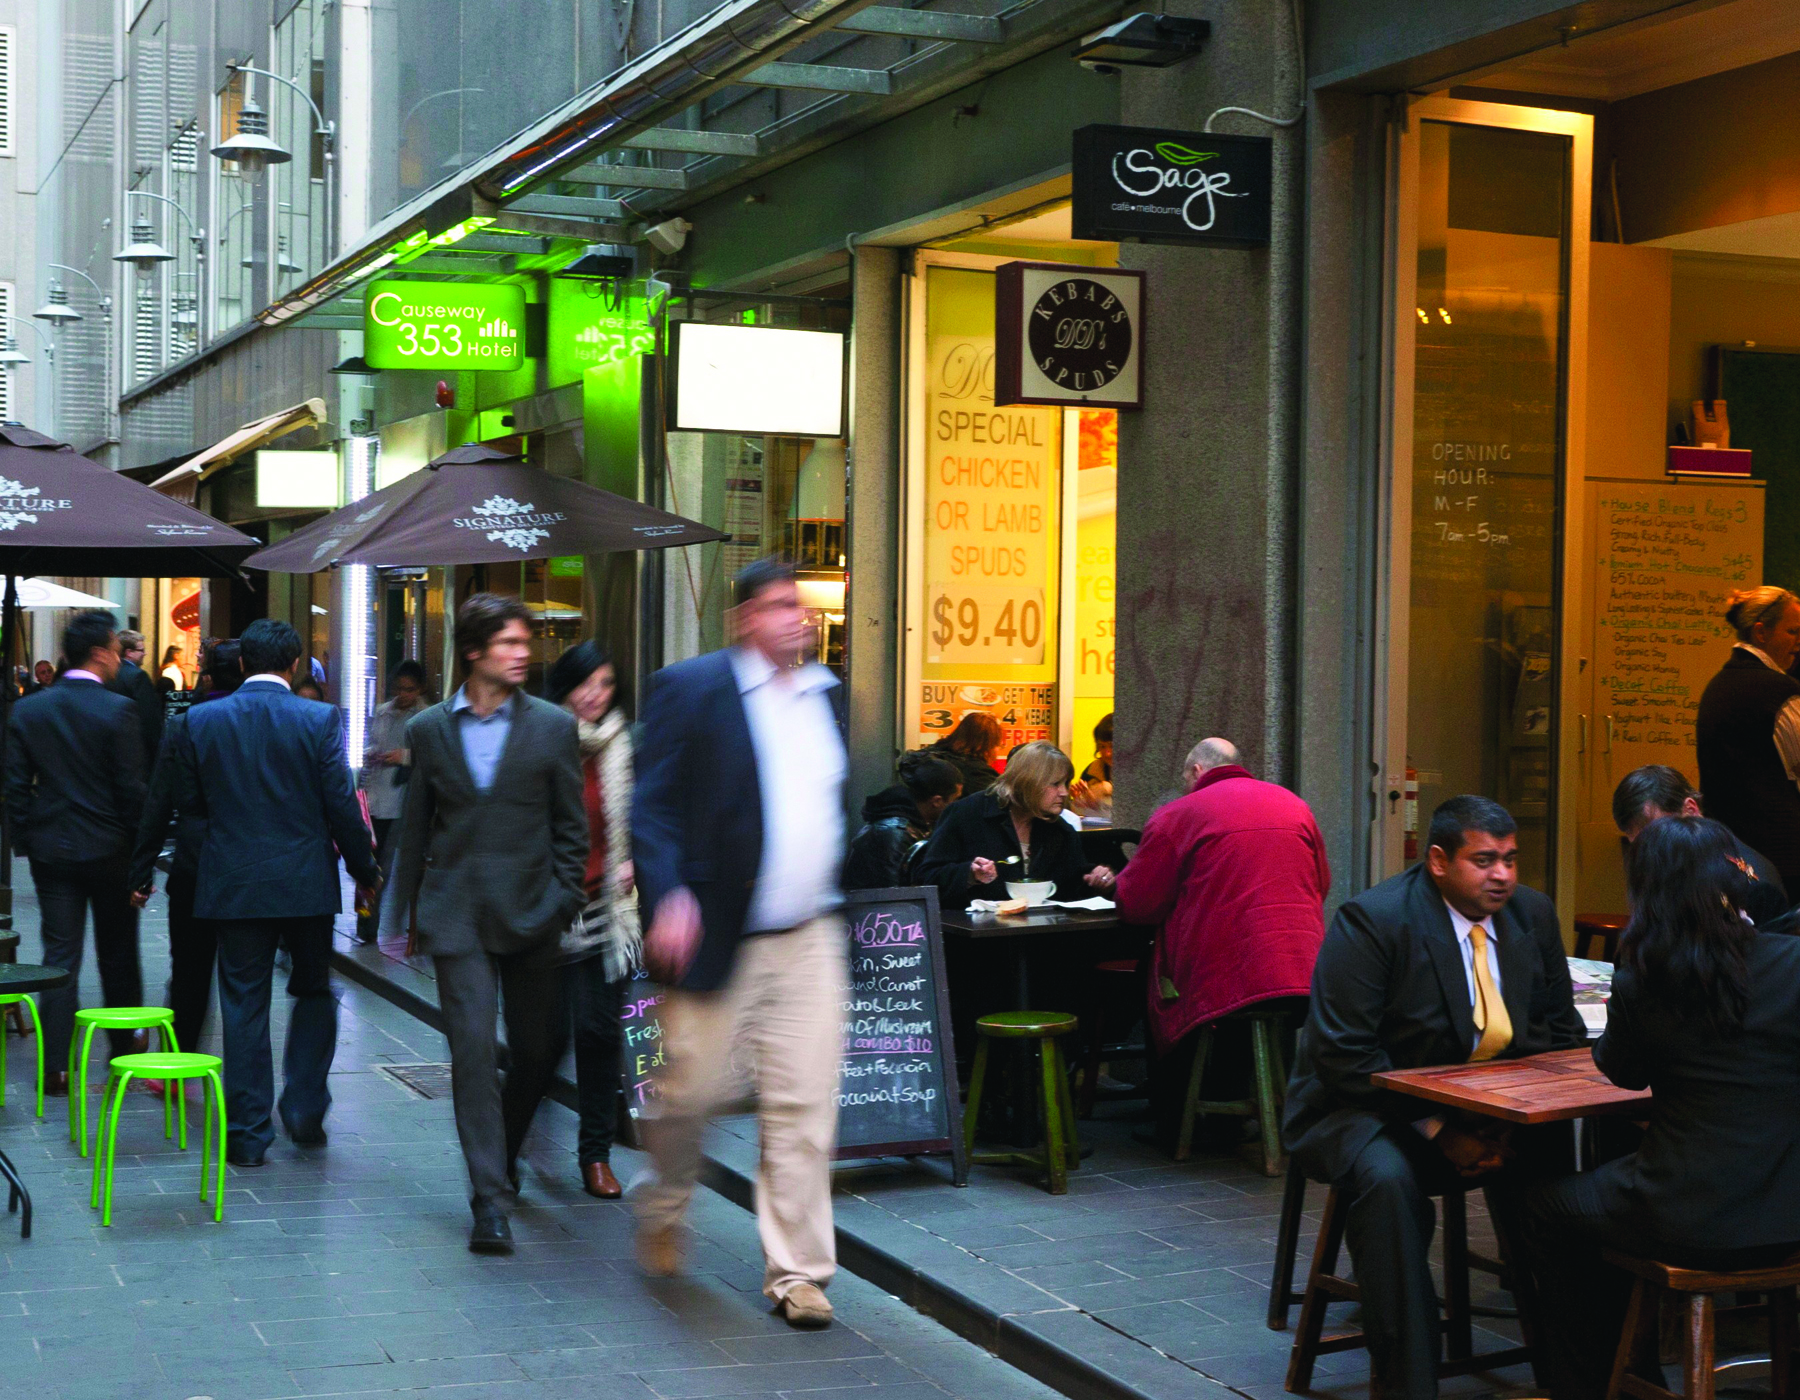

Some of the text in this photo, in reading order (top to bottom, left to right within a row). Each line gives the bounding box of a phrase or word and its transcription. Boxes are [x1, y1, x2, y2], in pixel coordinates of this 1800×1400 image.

[1112, 148, 1250, 231] Sage
[370, 291, 486, 326] Causeway
[1035, 282, 1127, 323] KEBABS
[397, 322, 517, 358] 353 Hotel
[1040, 356, 1119, 390] SPUDS
[937, 409, 1043, 447] SPECIAL
[1432, 443, 1511, 462] OPENING
[940, 455, 1040, 489] CHICKEN
[0, 497, 73, 509] TURE
[452, 511, 568, 528] SIGNATURE
[936, 500, 1042, 533] OR LAMB
[1610, 498, 1650, 512] House
[1658, 498, 1695, 514] Blend
[951, 544, 1026, 577] SPUDS
[932, 593, 1041, 652] $9.40
[922, 685, 958, 704] BUY
[1003, 687, 1052, 705] GET THE
[923, 709, 954, 729] 3
[1002, 729, 1048, 746] FREE
[882, 952, 922, 970] Sweet
[636, 1041, 667, 1076] Eat
